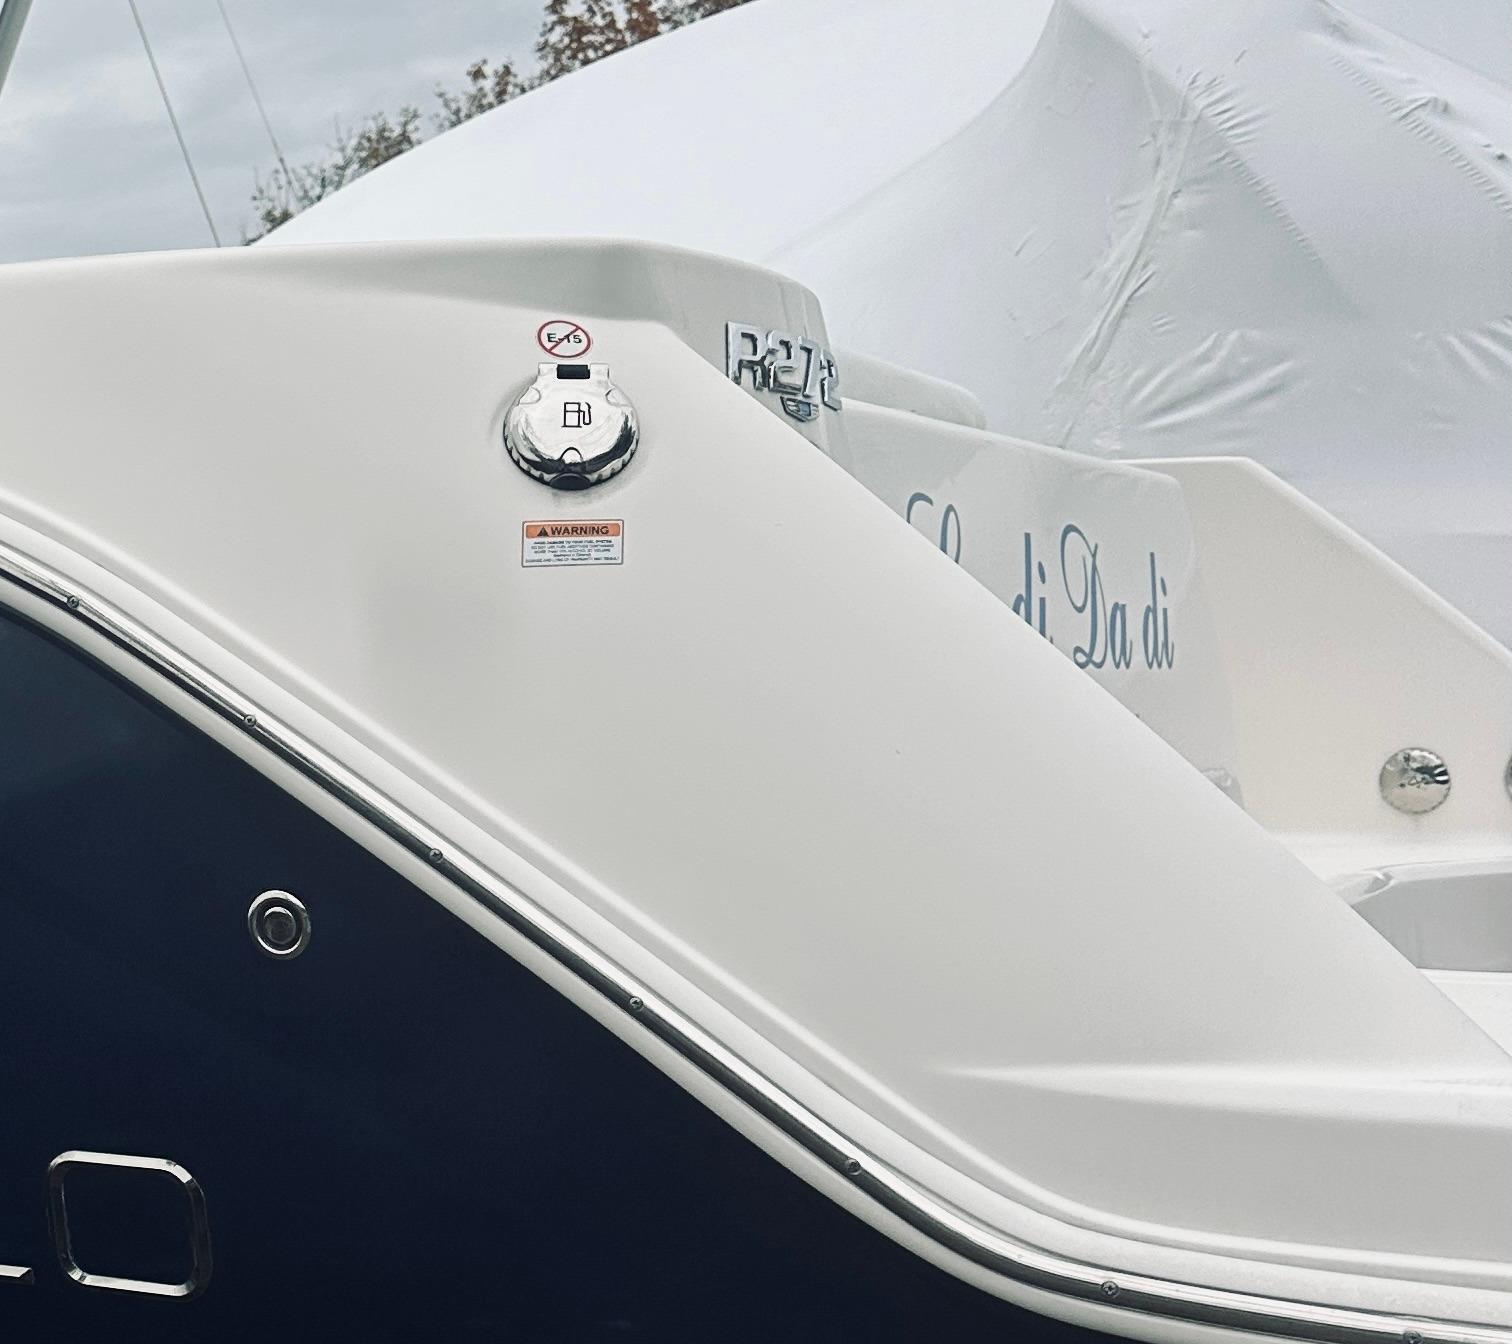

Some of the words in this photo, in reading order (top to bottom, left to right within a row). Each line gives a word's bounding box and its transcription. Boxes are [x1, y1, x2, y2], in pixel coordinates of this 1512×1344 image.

[550, 525, 610, 536] WARNING
[1060, 523, 1133, 670] Da
[1142, 551, 1175, 670] di
